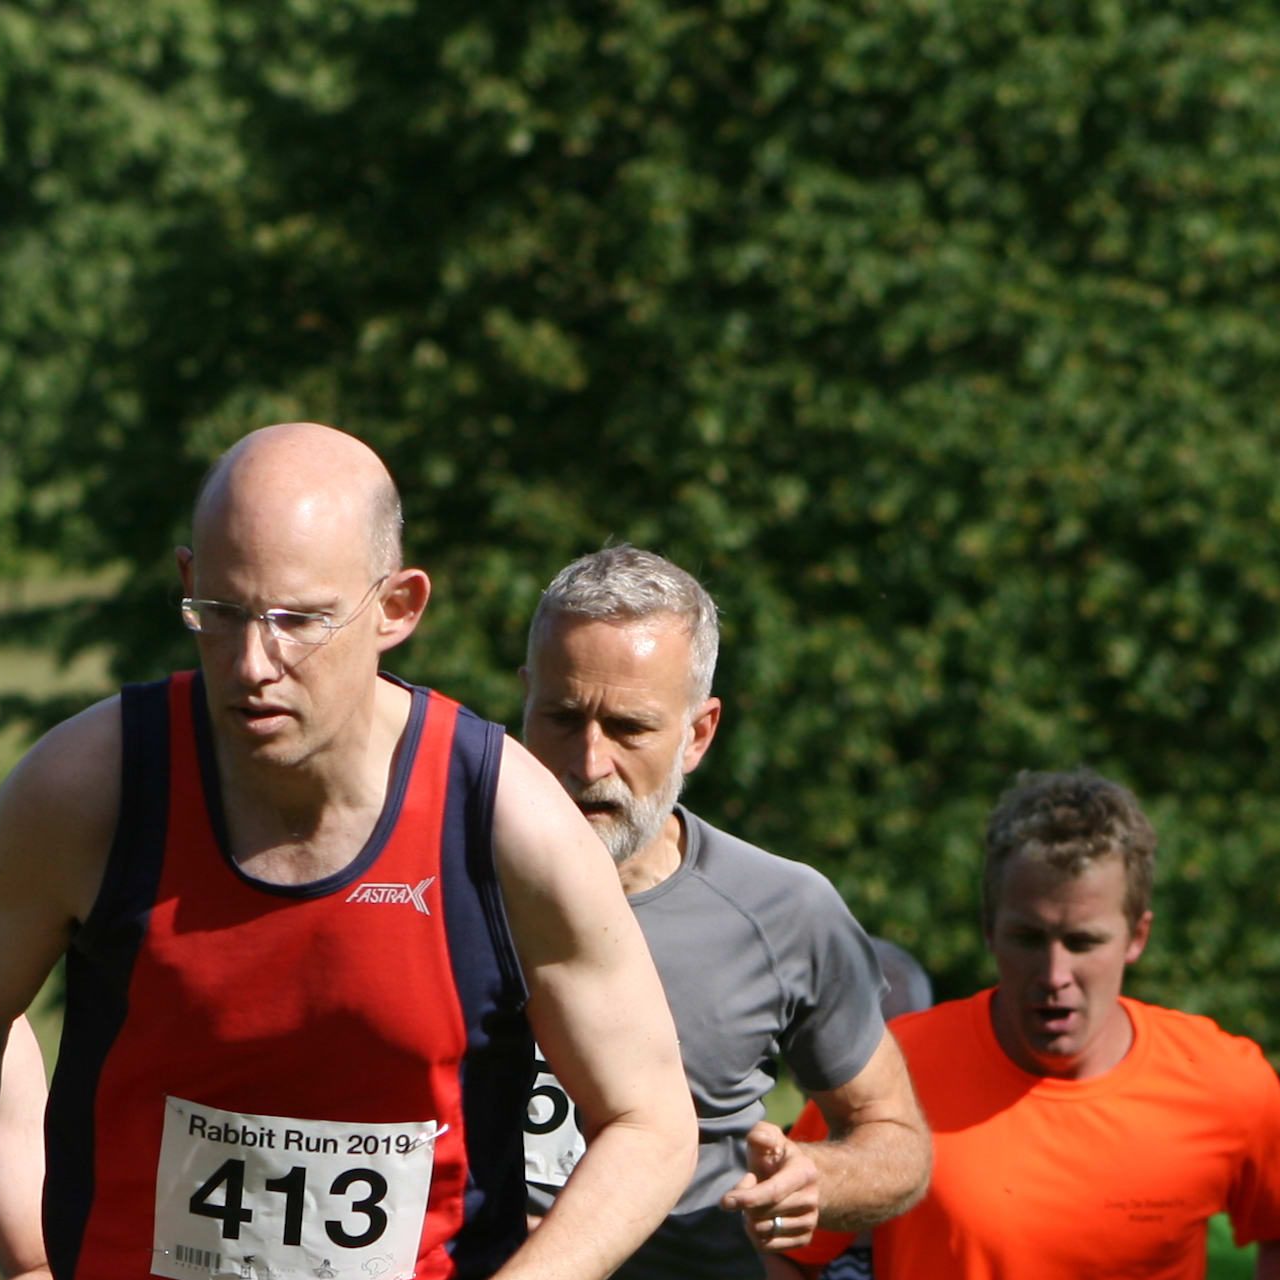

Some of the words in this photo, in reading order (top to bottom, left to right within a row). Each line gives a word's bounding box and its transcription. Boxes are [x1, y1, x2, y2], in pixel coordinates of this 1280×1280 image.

[345, 876, 436, 916] FASTRAX
[188, 1114, 276, 1149] Rabbit
[284, 1130, 338, 1154] Run
[346, 1134, 412, 1155] 2019
[189, 1158, 388, 1249] 413
